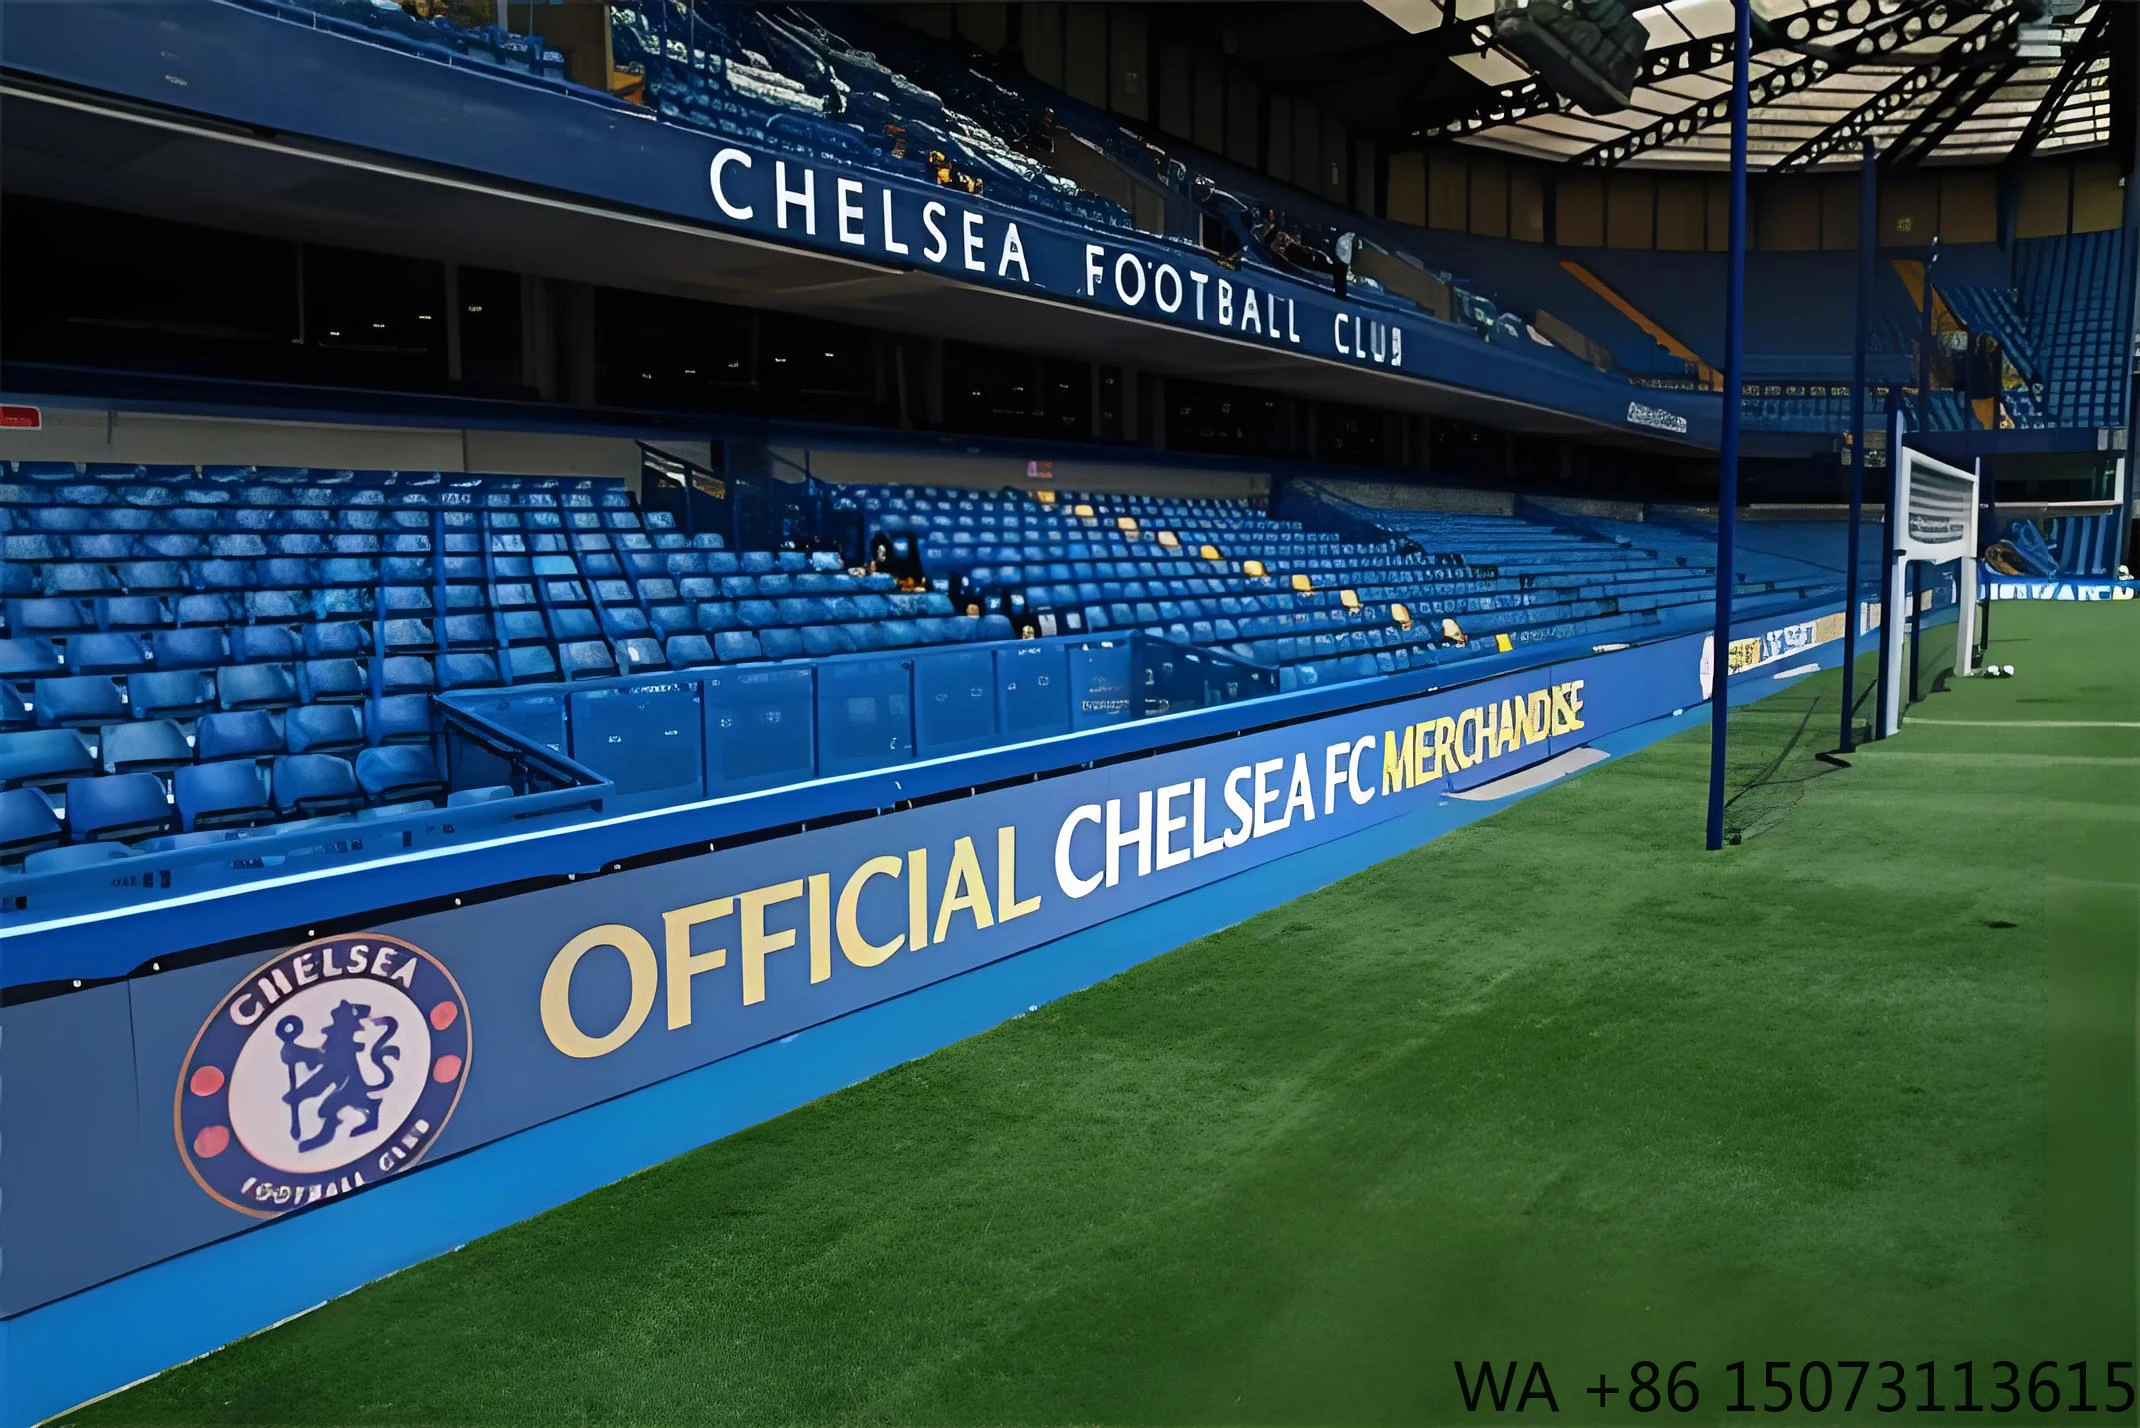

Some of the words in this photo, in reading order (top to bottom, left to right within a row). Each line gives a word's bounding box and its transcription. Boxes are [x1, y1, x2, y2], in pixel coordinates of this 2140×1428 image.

[710, 148, 1030, 282] CHELSEA
[1085, 244, 1300, 342] FOOTBALL
[540, 826, 1041, 1058] OFFICIAL
[1055, 752, 1316, 899] CHELSEA
[1325, 735, 1376, 815] FC
